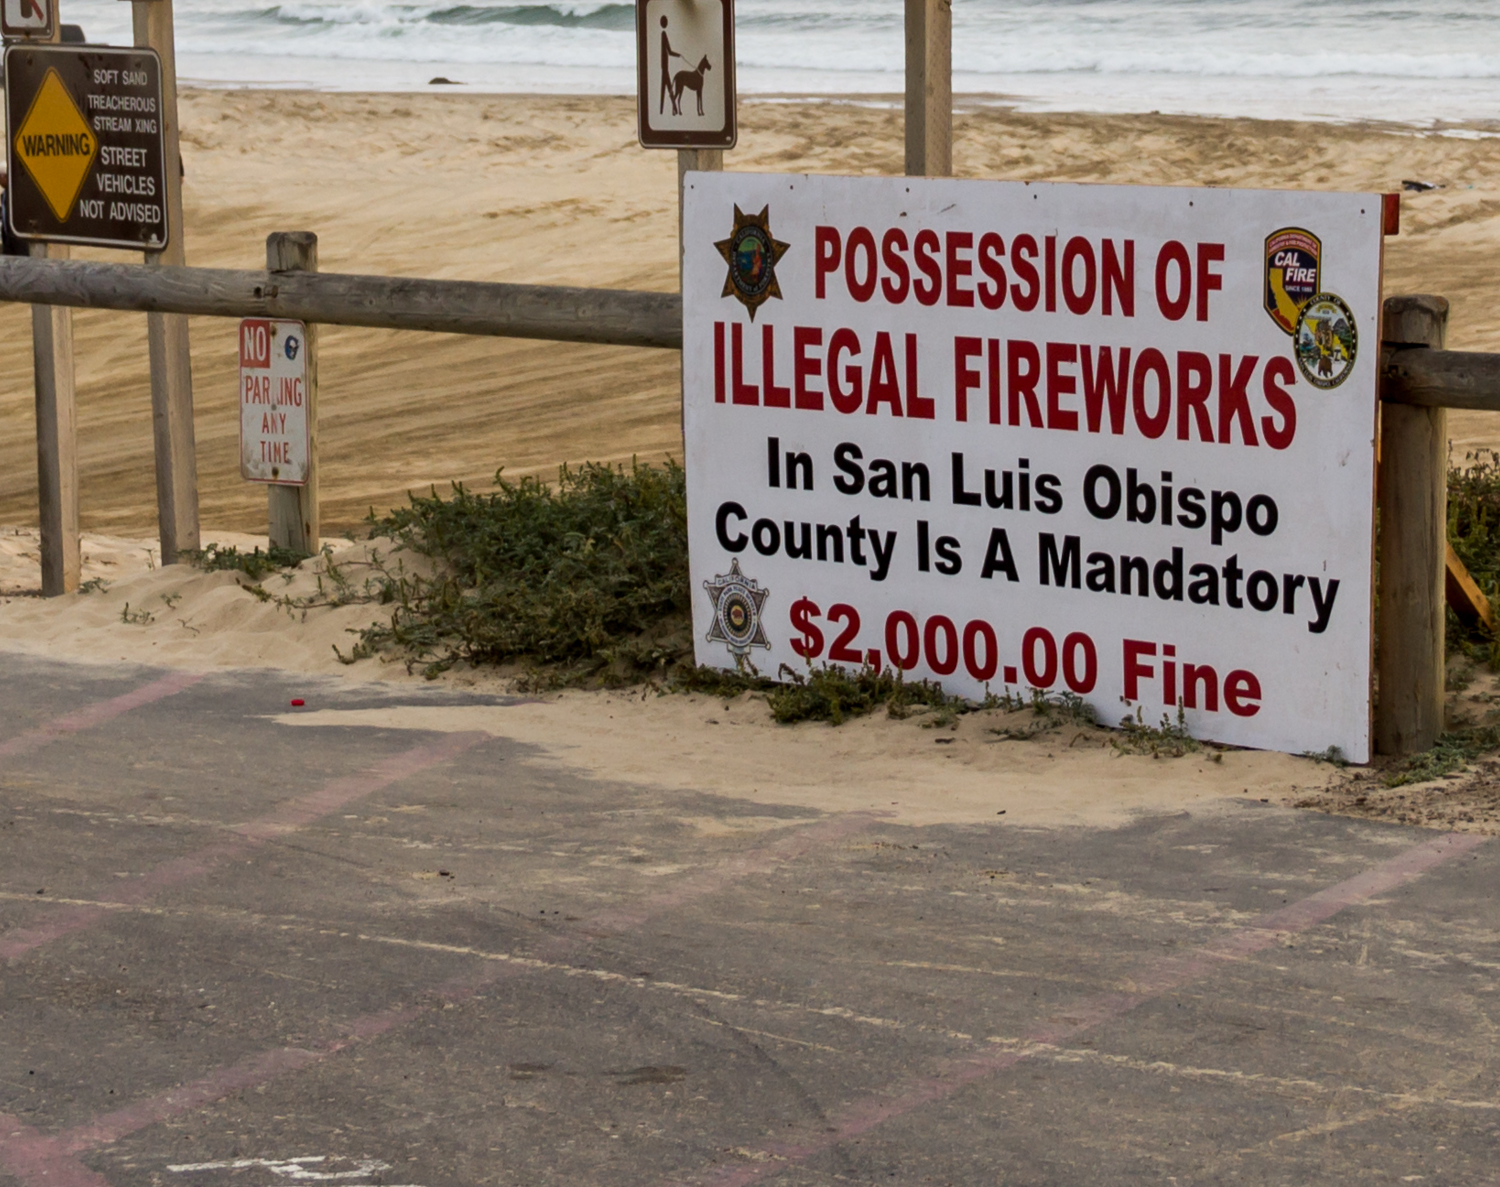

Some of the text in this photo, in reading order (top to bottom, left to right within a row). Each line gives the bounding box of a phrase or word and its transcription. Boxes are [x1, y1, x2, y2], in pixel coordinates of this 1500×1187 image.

[94, 69, 147, 86] SOFT SAND
[88, 95, 156, 112] TREACHEROUS
[93, 116, 156, 134] STREAM XING
[22, 134, 90, 157] WARNING
[101, 147, 147, 167] STREET
[96, 173, 155, 196] VEHICLES
[80, 199, 161, 223] NOT ADVISED
[1275, 251, 1300, 267] CAL
[815, 225, 1136, 318] POSSESSION
[1155, 240, 1225, 322] OF
[1286, 268, 1316, 282] FIRE
[1310, 296, 1330, 305] COUNTY
[244, 326, 266, 361] NO
[245, 376, 302, 407] PARING
[713, 321, 1298, 450] ILLEGAL FIREWORKS
[262, 412, 286, 434] ANY
[260, 441, 289, 464] TIME
[768, 436, 1279, 546] In San Luis Obispo
[715, 501, 1340, 634] County Is A Mandatory
[718, 576, 756, 589] CALIFORNIA
[789, 596, 1263, 718] $2,000.00 Fine
